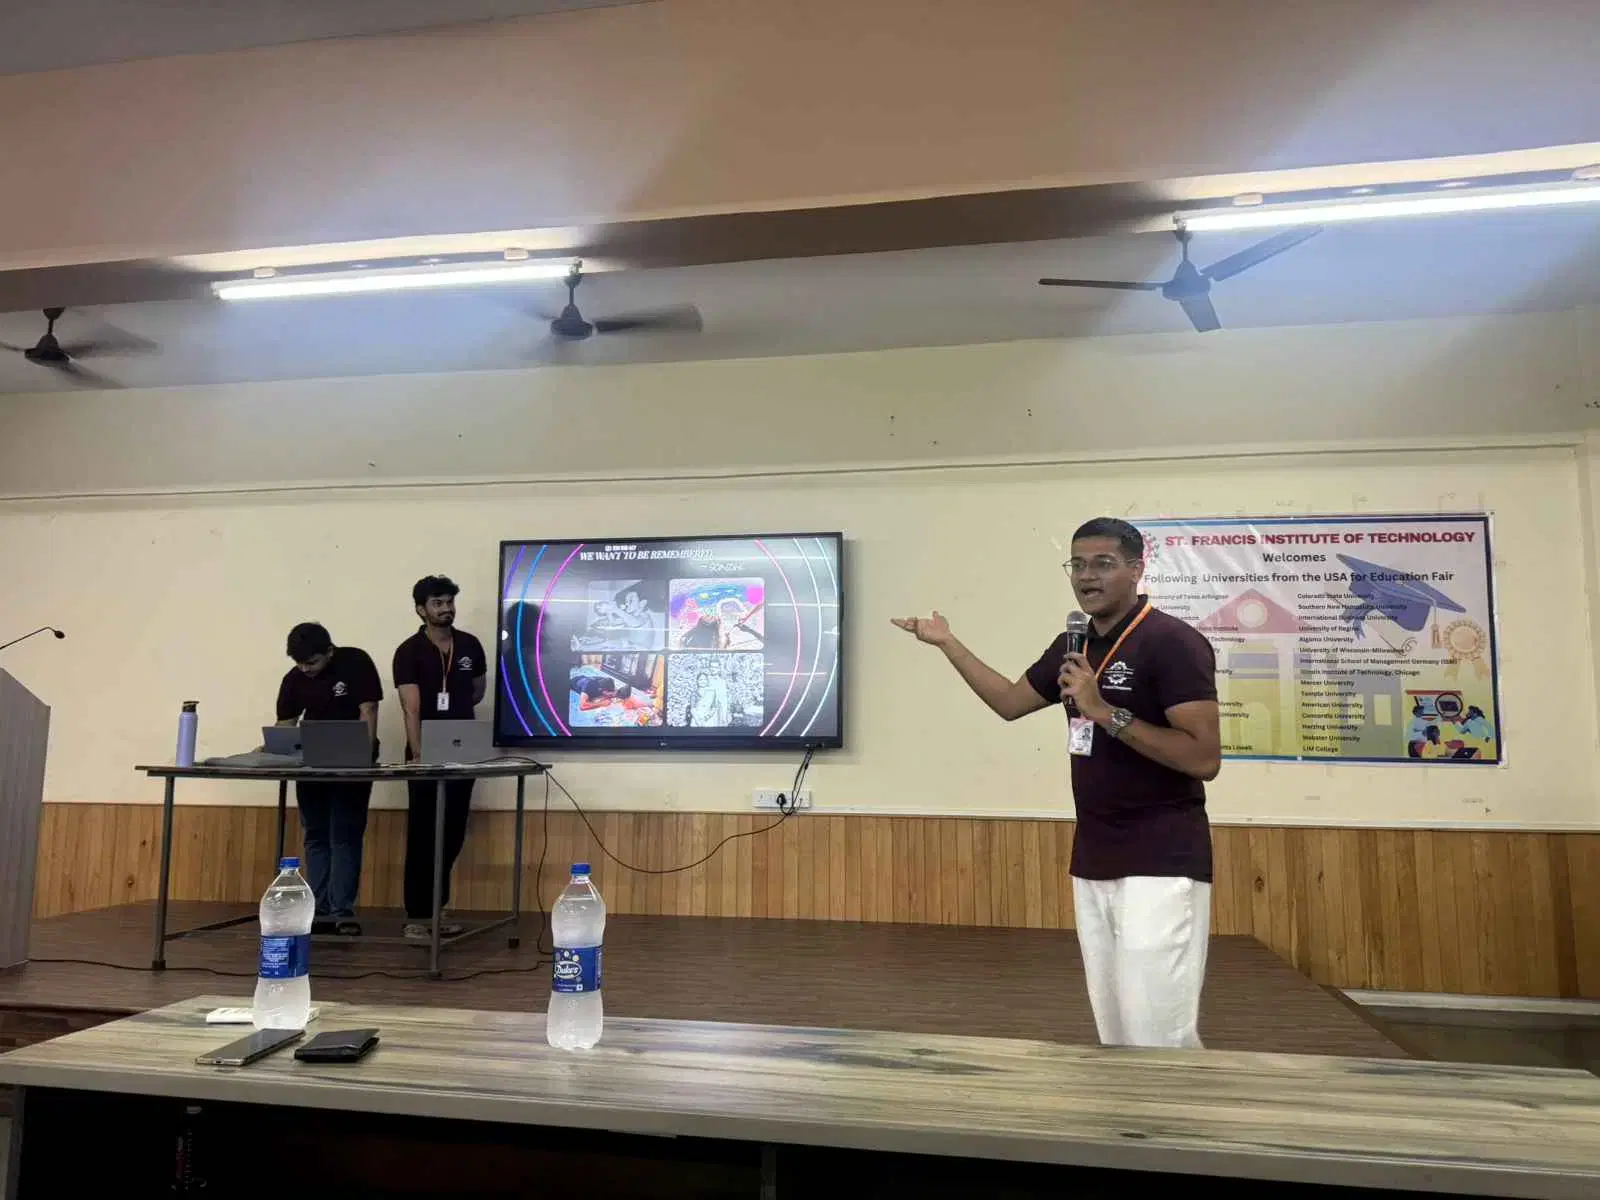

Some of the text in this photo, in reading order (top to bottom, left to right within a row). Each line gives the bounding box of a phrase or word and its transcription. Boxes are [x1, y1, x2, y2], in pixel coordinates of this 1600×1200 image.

[1192, 535, 1256, 545] FRANCIS
[1261, 533, 1340, 545] INSTITUTE
[1344, 532, 1364, 544] OF
[1368, 531, 1476, 544] TECHNOLOGY
[580, 552, 594, 561] WE
[596, 551, 621, 561] WANT
[623, 551, 636, 560] TO
[638, 550, 649, 560] BE
[1263, 552, 1327, 563] Welcomes
[1145, 571, 1455, 585] Following Universities from the USA for Education Fair
